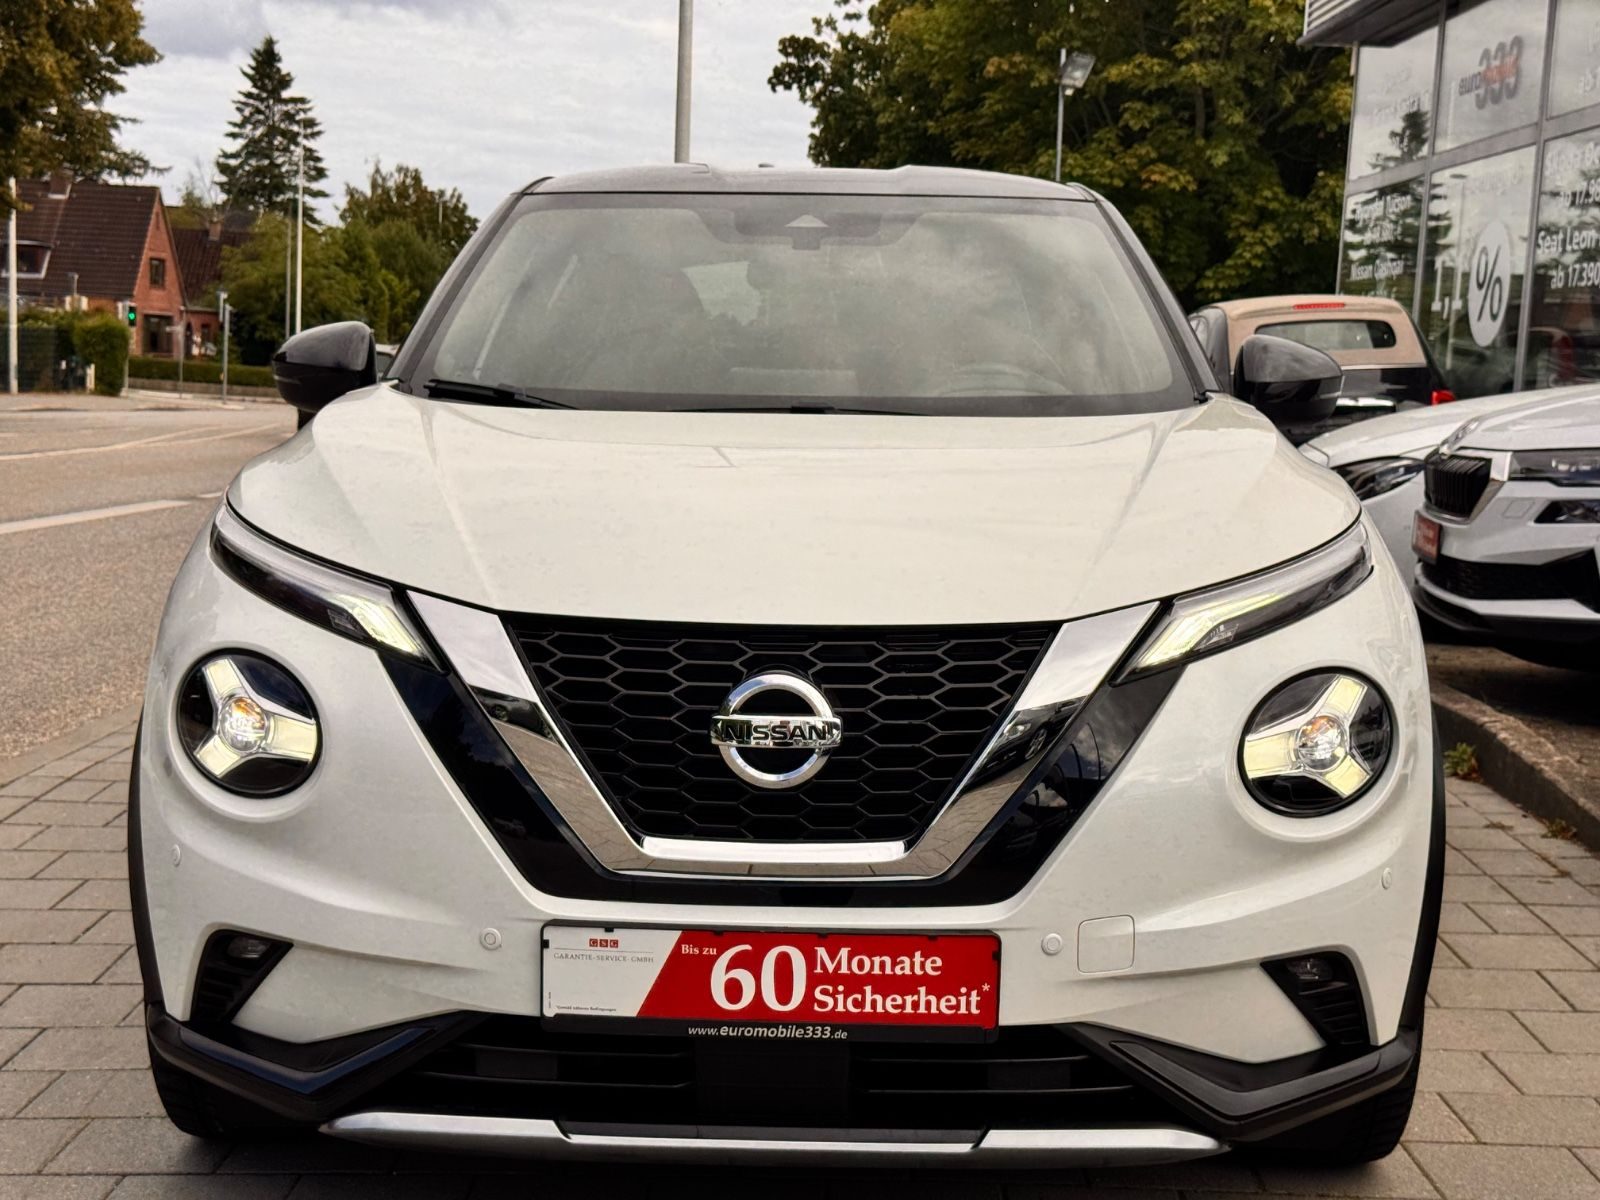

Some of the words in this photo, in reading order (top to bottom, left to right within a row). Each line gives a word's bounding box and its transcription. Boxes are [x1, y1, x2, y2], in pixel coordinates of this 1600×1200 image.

[1575, 178, 1600, 205] 17.98
[1537, 230, 1563, 254] Seat
[1566, 226, 1597, 251] Leon
[1551, 264, 1565, 289] ab
[1568, 261, 1600, 288] 17.390
[723, 725, 827, 741] NISSAN
[681, 944, 700, 955] Bis
[702, 946, 718, 956] zu
[813, 946, 943, 976] Monate
[710, 944, 807, 1012] 60
[688, 1025, 848, 1040] www.euromobile333.de
